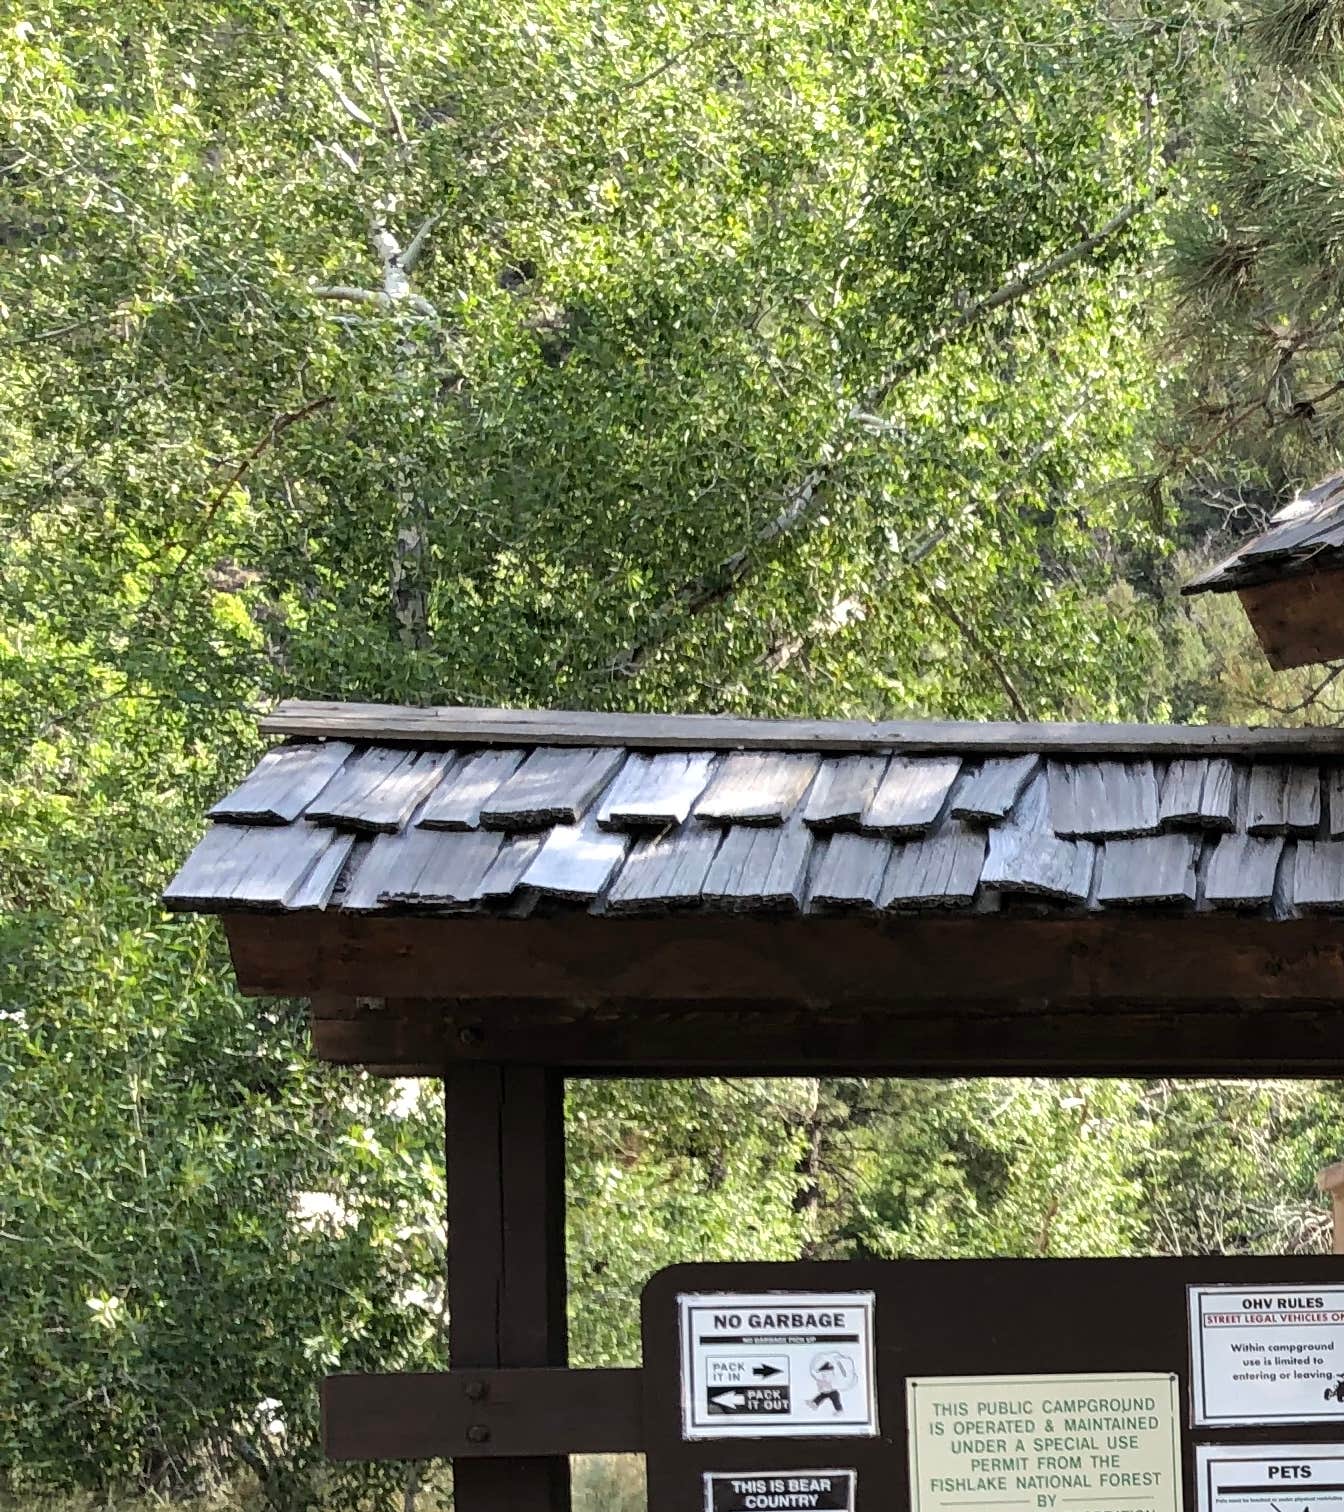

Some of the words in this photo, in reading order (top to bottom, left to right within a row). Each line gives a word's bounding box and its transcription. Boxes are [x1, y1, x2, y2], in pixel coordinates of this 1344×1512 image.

[1242, 1298, 1272, 1309] OHV
[1278, 1298, 1324, 1309] RULES
[714, 1315, 741, 1328] NO
[748, 1313, 845, 1328] GARBAGE
[1208, 1314, 1241, 1324] STREET
[1245, 1314, 1277, 1323] LEGAL
[1281, 1313, 1328, 1322] VEHICLES
[1231, 1343, 1265, 1352] Within
[1268, 1342, 1334, 1353] campground
[713, 1362, 745, 1372] PACK
[1243, 1359, 1260, 1367] use
[1264, 1357, 1271, 1365] is
[1275, 1357, 1310, 1365] limited
[1314, 1357, 1324, 1365] to
[713, 1373, 726, 1382] IT
[729, 1373, 741, 1382] IN
[1233, 1372, 1276, 1382] entering
[1280, 1372, 1290, 1380] or
[747, 1390, 781, 1400] PACK
[748, 1400, 760, 1409] IT
[763, 1400, 789, 1409] OUT
[933, 1403, 968, 1416] THIS
[978, 1401, 1032, 1415] PUBLIC
[1042, 1398, 1155, 1414] CAMPGROUND
[930, 1423, 944, 1435] IS
[954, 1420, 1035, 1435] OPERATED
[1045, 1420, 1055, 1433] &
[1065, 1416, 1159, 1432] MAINTAINED
[952, 1440, 1006, 1454] UNDER
[1016, 1439, 1025, 1452] A
[1034, 1438, 1098, 1451] SPECIAL
[1108, 1436, 1139, 1449] USE
[971, 1457, 1028, 1471] PERMIT
[1038, 1456, 1081, 1470] FROM
[1090, 1455, 1120, 1468] THE
[1269, 1465, 1311, 1479] PETS
[731, 1480, 766, 1493] THIS
[770, 1480, 785, 1492] IS
[788, 1479, 831, 1492] BEAR
[931, 1476, 1006, 1492] FISHLAKE
[1016, 1475, 1091, 1489] NATIONAL
[1100, 1473, 1161, 1487] FOREST
[745, 1494, 818, 1508] COUNTRY
[1037, 1494, 1056, 1508] BY
